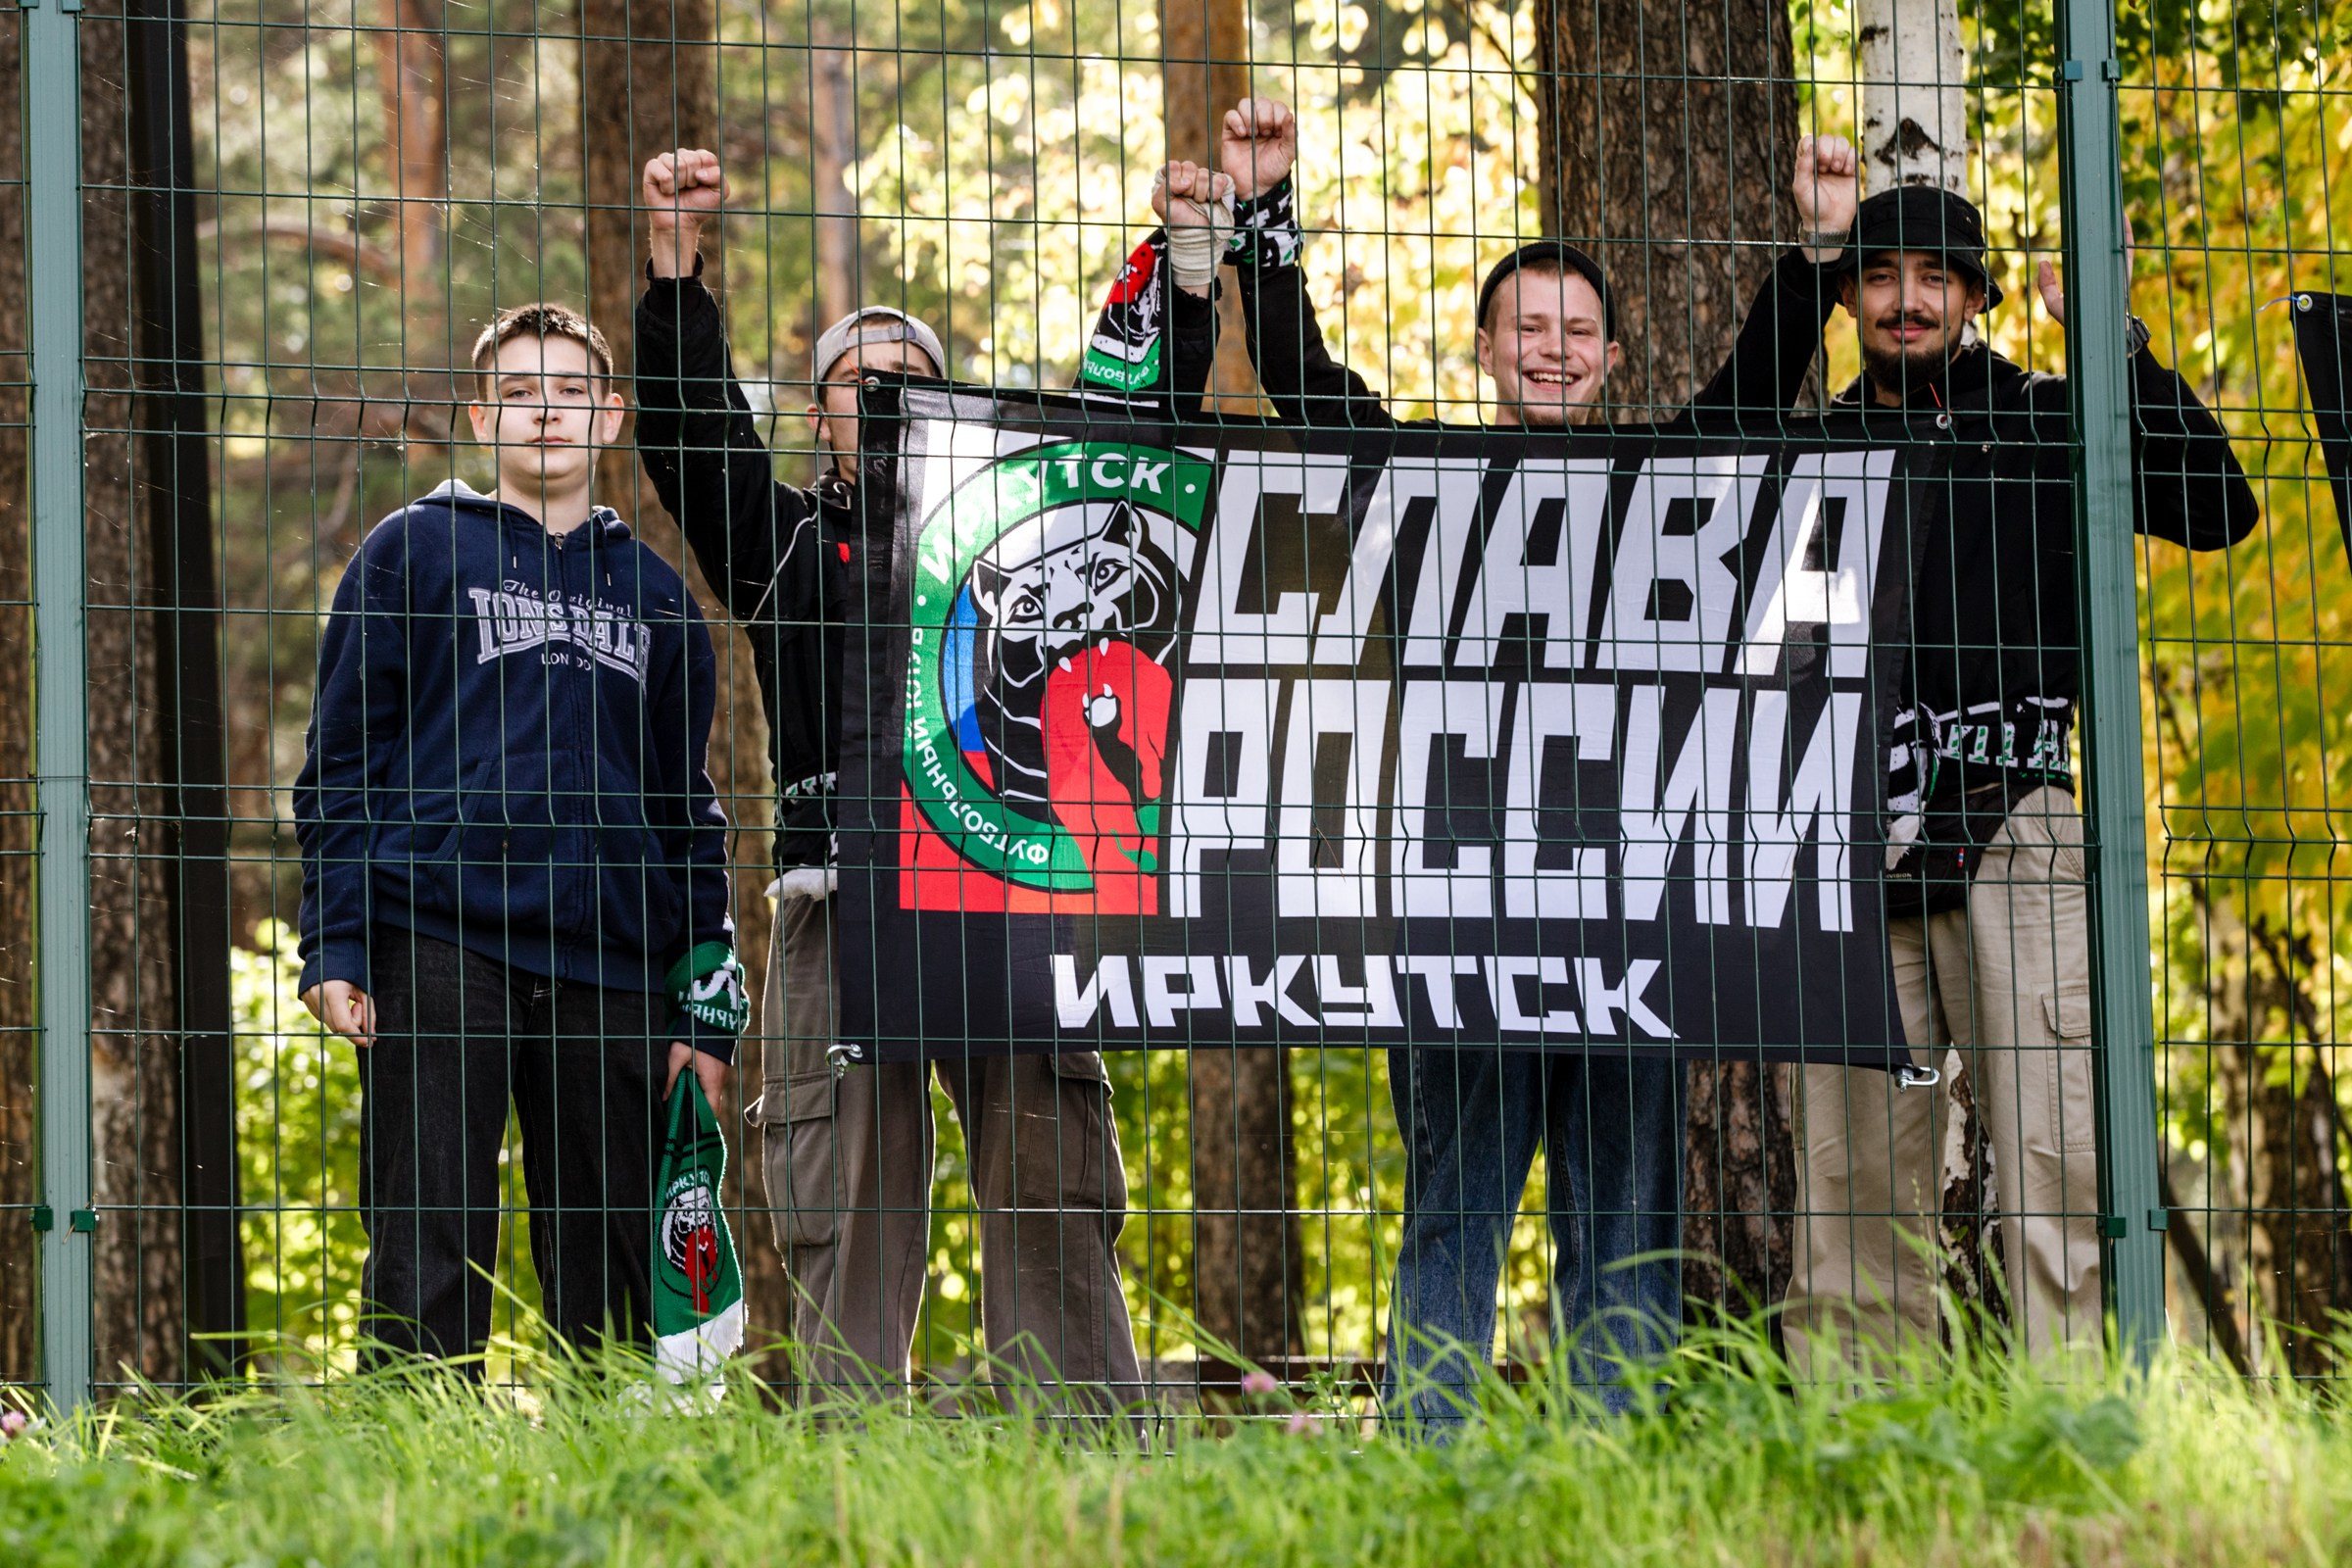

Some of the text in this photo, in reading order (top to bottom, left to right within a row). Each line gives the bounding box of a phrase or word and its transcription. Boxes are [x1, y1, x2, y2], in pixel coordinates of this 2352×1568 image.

[920, 453, 1171, 585] ИРКУТСК
[1188, 449, 1896, 678] СЛАВА
[468, 587, 652, 678] LONSDALE
[502, 579, 539, 599] The
[541, 652, 592, 671] LONDO
[907, 716, 1050, 865] ФУТБОЛЬНЫЙ
[1168, 678, 1863, 933] РОССИИ
[1050, 955, 1681, 1039] ИРКУТСК
